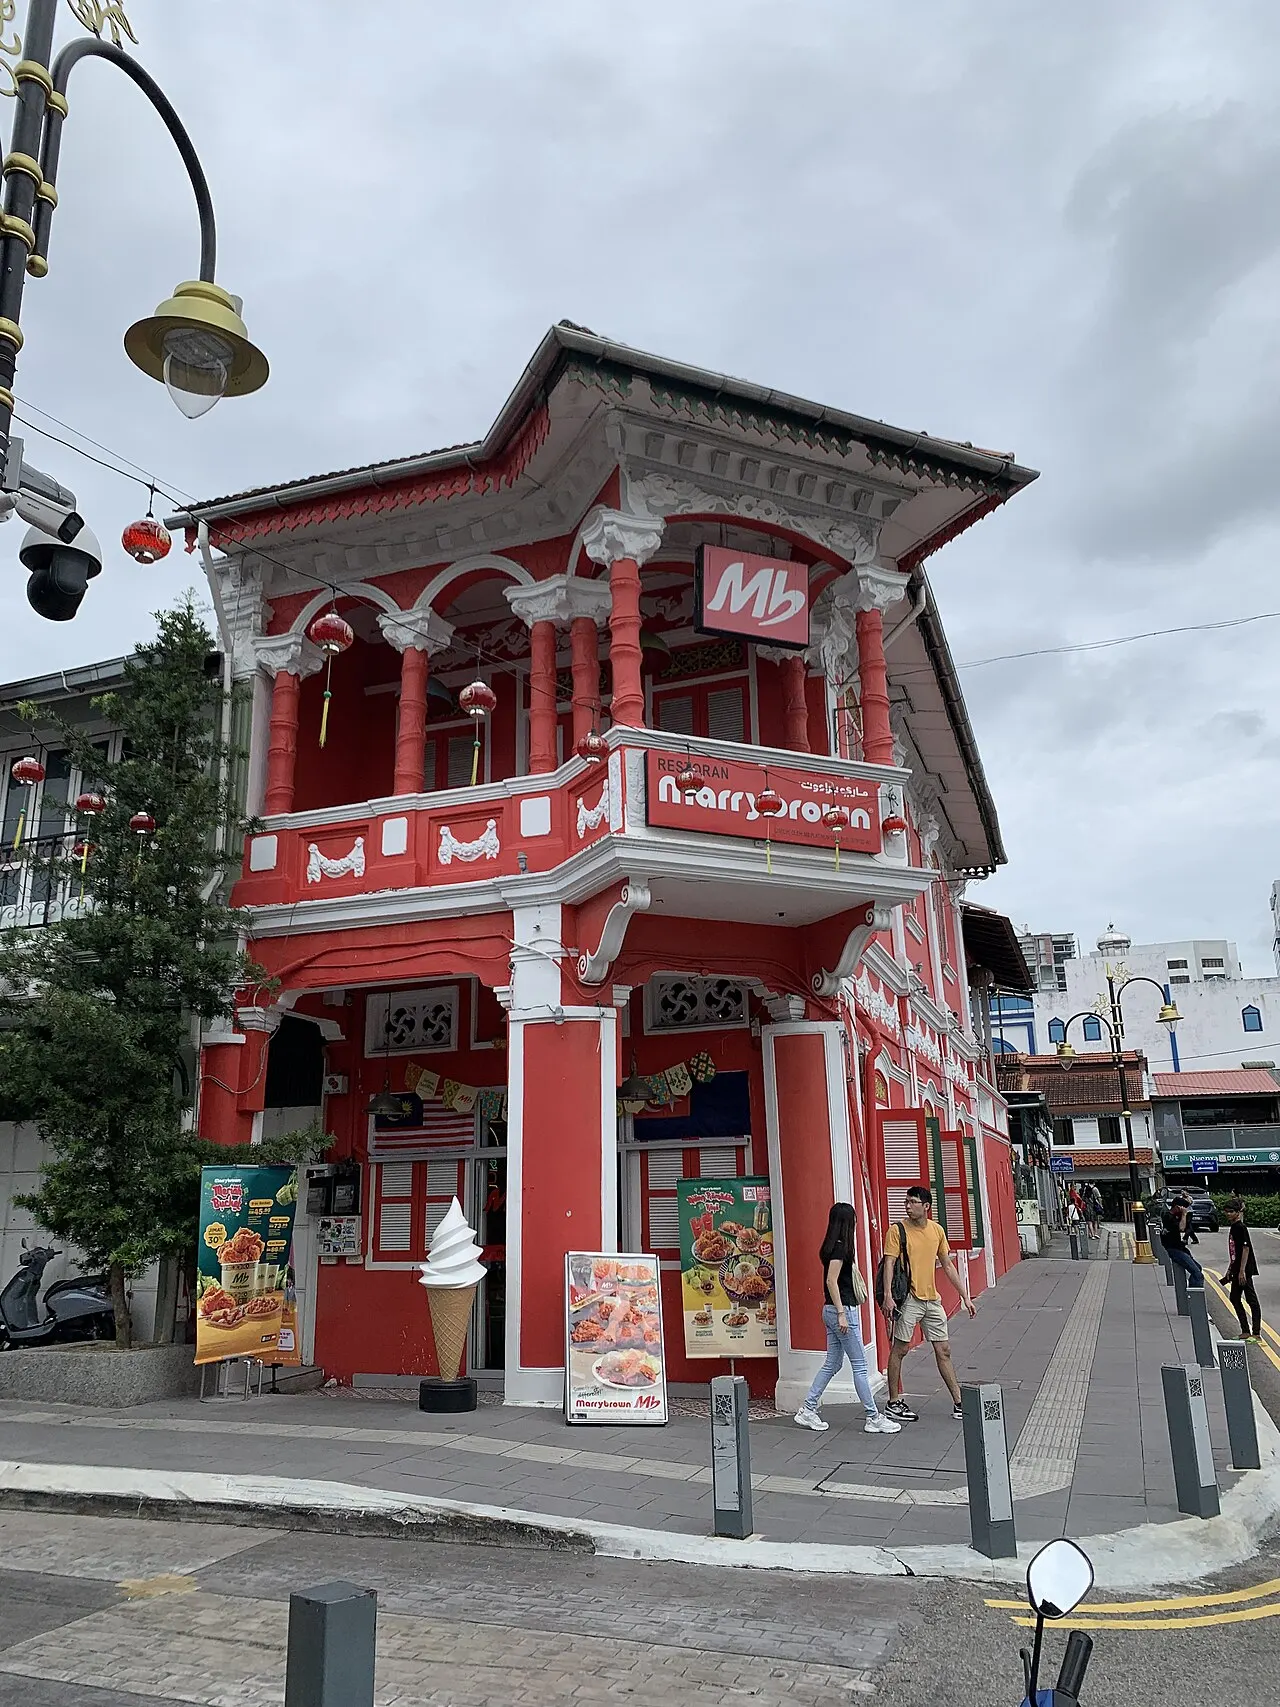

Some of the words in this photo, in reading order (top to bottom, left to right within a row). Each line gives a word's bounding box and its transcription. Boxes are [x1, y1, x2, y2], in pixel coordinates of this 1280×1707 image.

[706, 562, 806, 627] Mb
[1226, 1154, 1257, 1163] Dynasty
[576, 1399, 632, 1409] Marrybrown
[634, 1395, 661, 1411] Mb
